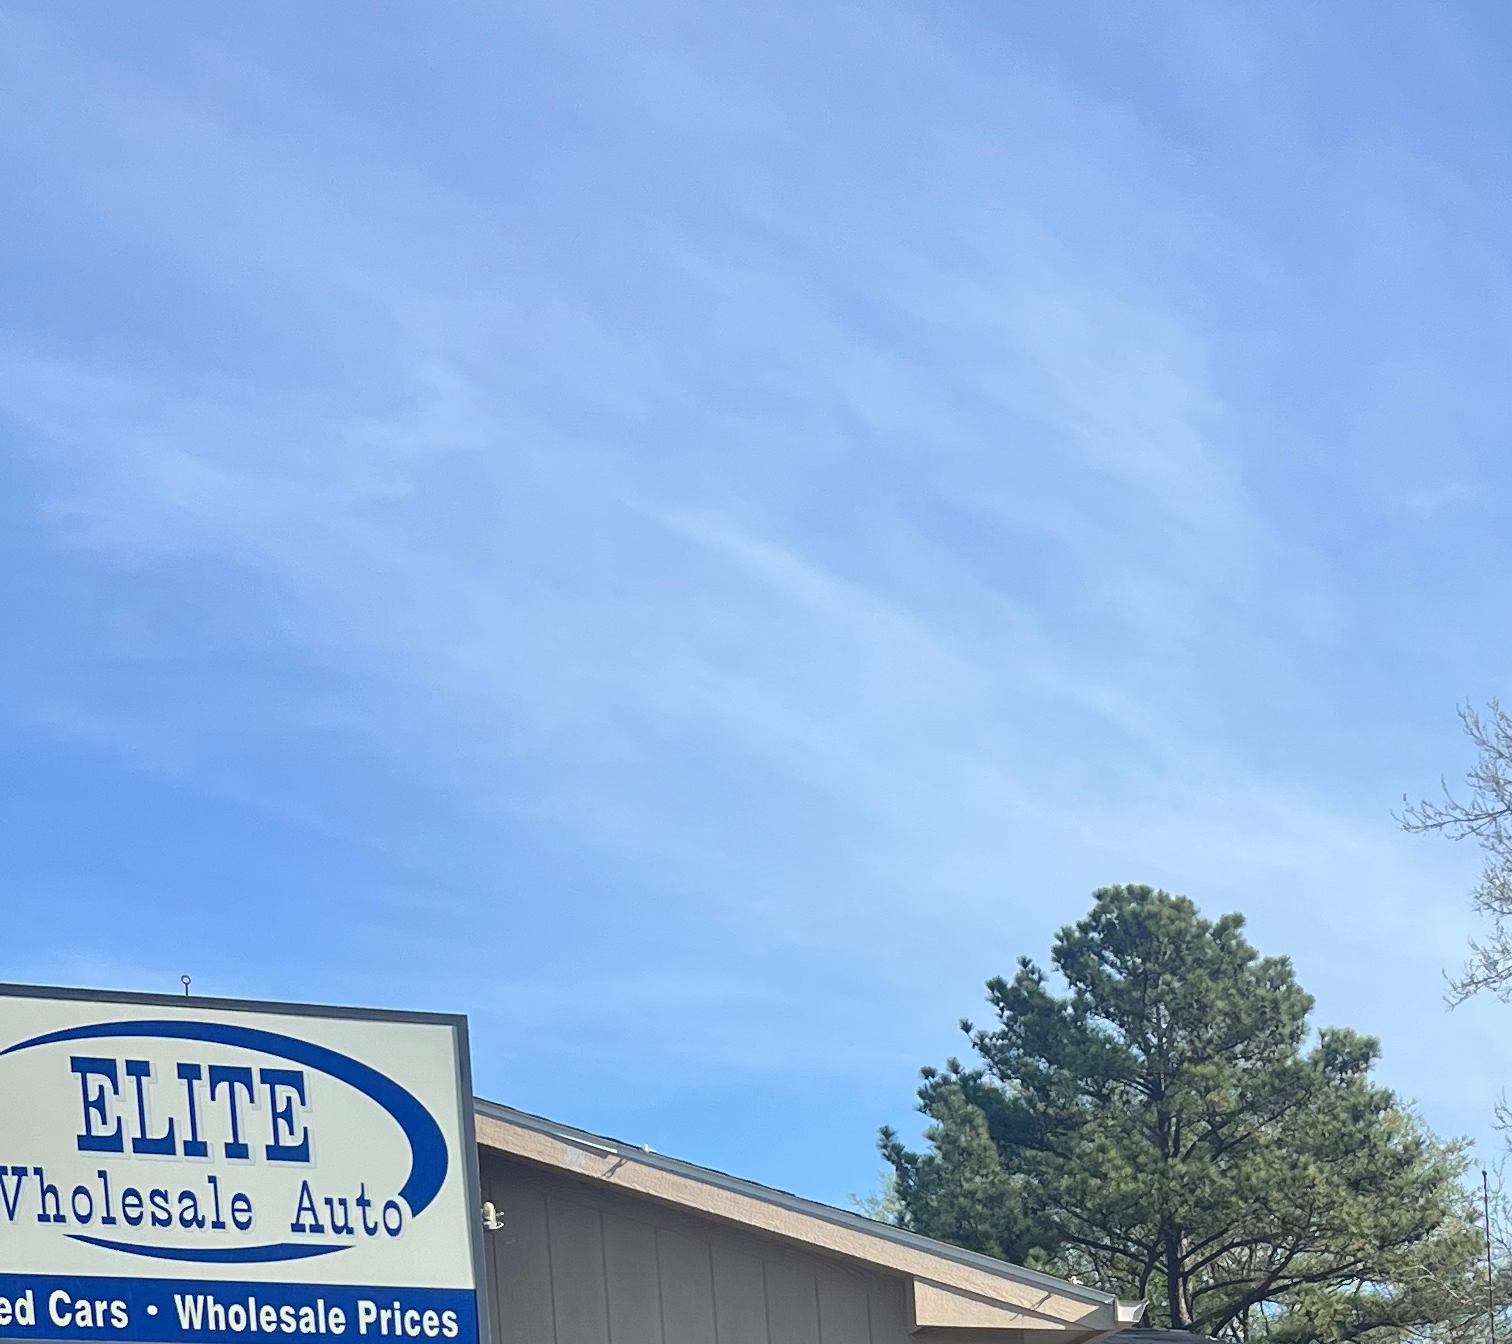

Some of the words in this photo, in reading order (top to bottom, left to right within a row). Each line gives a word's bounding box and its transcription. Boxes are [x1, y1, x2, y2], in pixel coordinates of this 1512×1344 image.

[70, 1055, 311, 1163] ELITE
[291, 1180, 403, 1237] Auto
[49, 1290, 129, 1329] Cars
[174, 1293, 346, 1335] Wholesale
[358, 1299, 459, 1338] Prices
